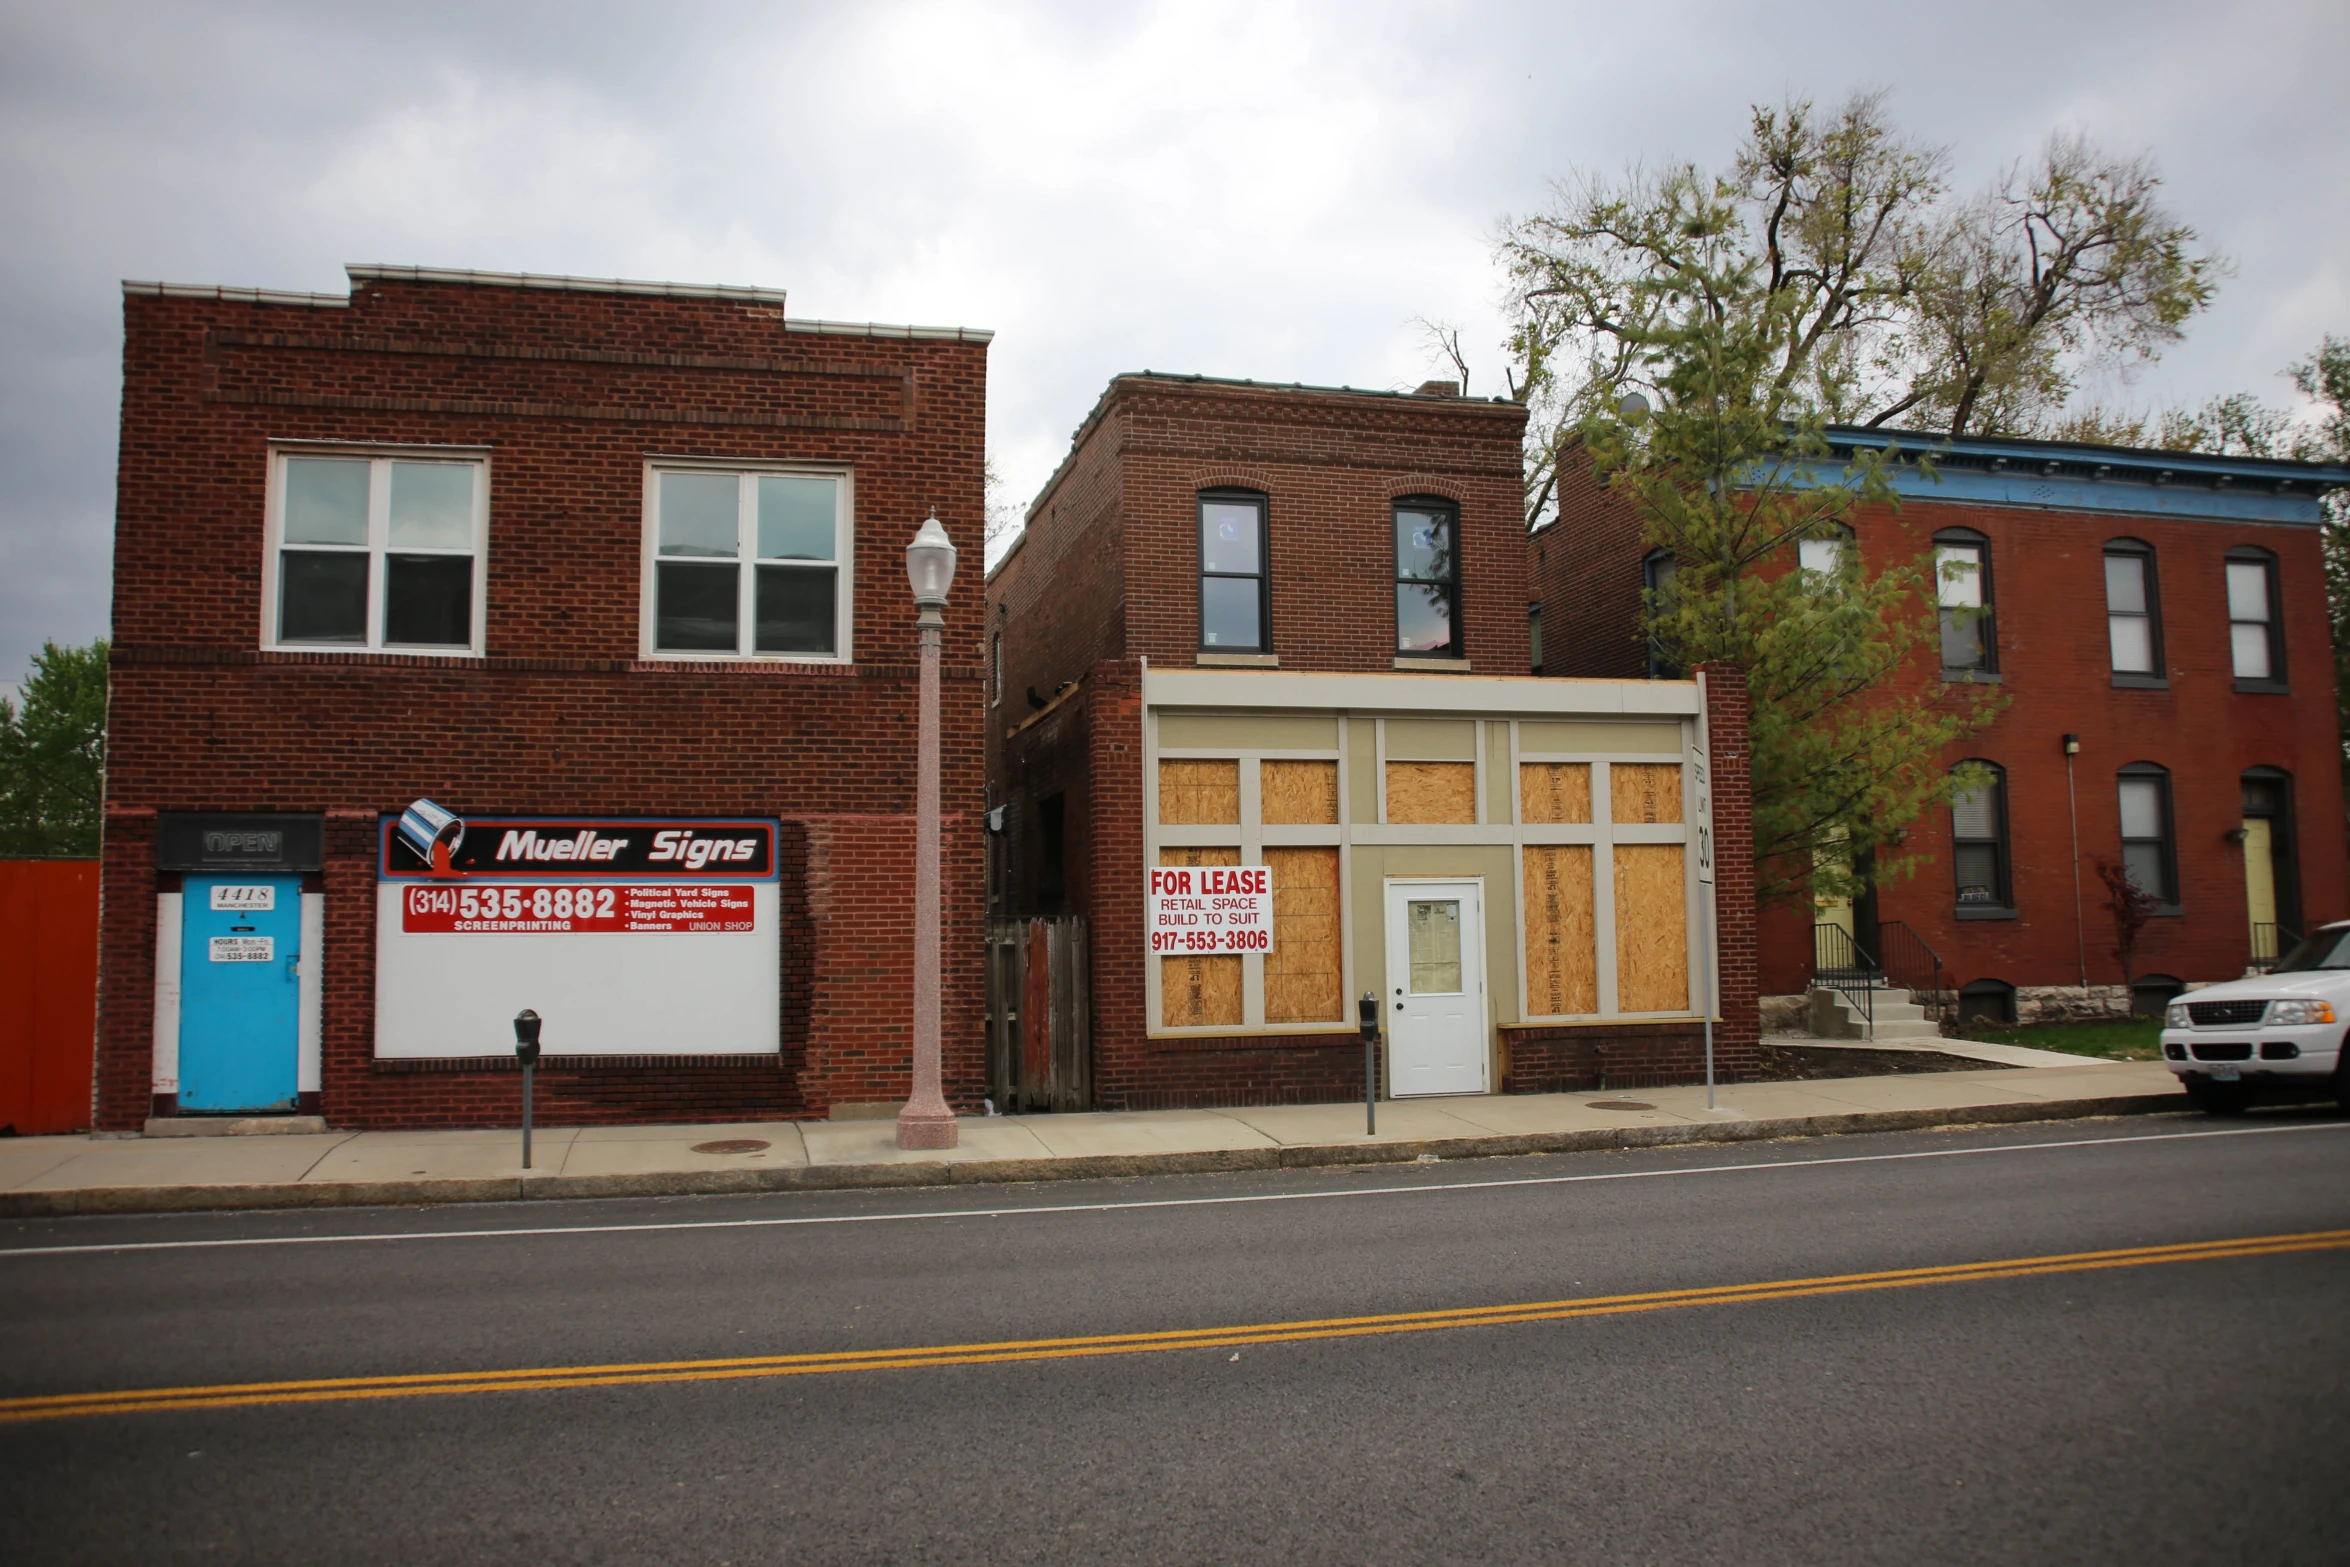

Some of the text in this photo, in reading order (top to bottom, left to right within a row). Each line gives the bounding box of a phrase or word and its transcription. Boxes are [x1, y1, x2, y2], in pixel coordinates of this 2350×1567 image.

[205, 832, 279, 852] OPEN
[1699, 826, 1710, 869] 30
[496, 830, 757, 869] Mueller Signs
[1151, 870, 1267, 895] FOR LEASE
[216, 887, 269, 901] 4418
[630, 888, 729, 899] Political Yard Signs
[409, 888, 456, 915] (314)
[630, 899, 749, 909] Magnetic Vehicle Signs
[1161, 898, 1257, 910] RETAIL SPACE
[630, 910, 704, 921] Vinyl Graphics
[1159, 913, 1260, 926] BUILD TO SUIT
[454, 921, 571, 931] SCREENPRINTING
[630, 921, 753, 931] Banners UNION SHOP
[1151, 930, 1268, 951] 917-553-3806
